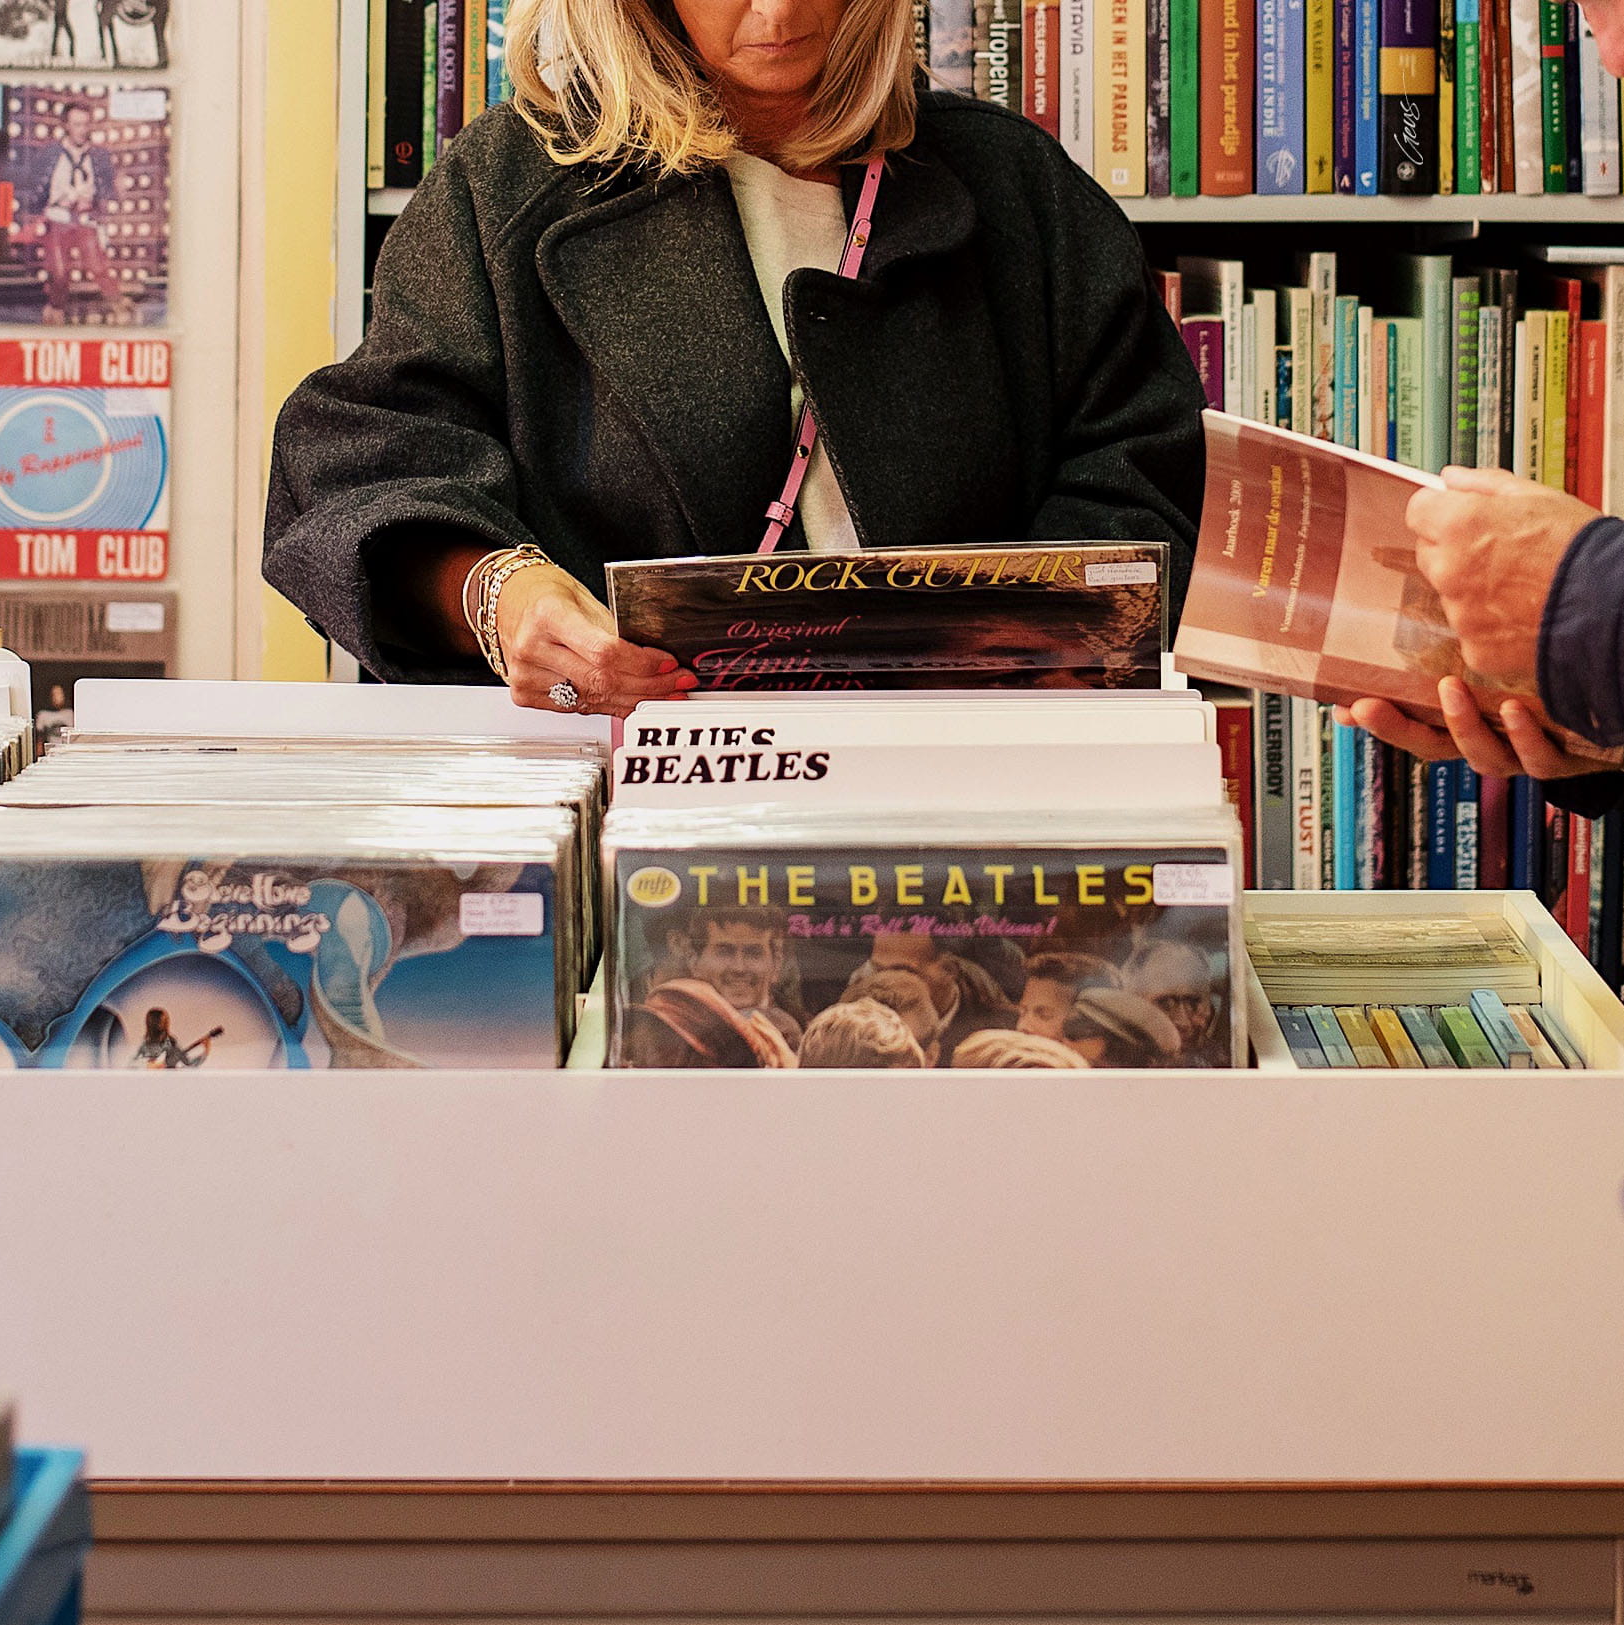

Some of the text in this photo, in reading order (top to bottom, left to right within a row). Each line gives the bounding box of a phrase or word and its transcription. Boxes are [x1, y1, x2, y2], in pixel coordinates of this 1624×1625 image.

[1113, 30, 1128, 45] IN
[1223, 32, 1240, 49] in
[975, 22, 1021, 106] tropenv
[1112, 51, 1128, 78] HET
[1223, 52, 1240, 80] het
[1263, 60, 1274, 81] UIT
[1112, 83, 1128, 153] PARADIJS
[1220, 84, 1240, 156] paradijs
[19, 341, 81, 384] TOM
[100, 341, 169, 385] CLUB
[1222, 478, 1243, 558] Jaarboek 2009
[16, 533, 78, 576] TOM
[97, 533, 166, 577] CLUB
[735, 558, 867, 594] ROCK
[884, 553, 1083, 589] GUITAR
[1251, 510, 1280, 598] Varen naar de
[725, 614, 854, 643] Original
[636, 727, 777, 746] BLUES
[1265, 693, 1285, 798] KILLERBODY
[621, 751, 831, 786] BEATLES
[1299, 768, 1314, 856] EETLUST
[1436, 766, 1447, 855] CHOCOLADE
[636, 872, 673, 896] mfp
[688, 864, 817, 907] THE
[849, 864, 1154, 907] BEATLES
[158, 900, 332, 956] Beginnings
[787, 913, 835, 938] Rock
[859, 914, 904, 937] Roll
